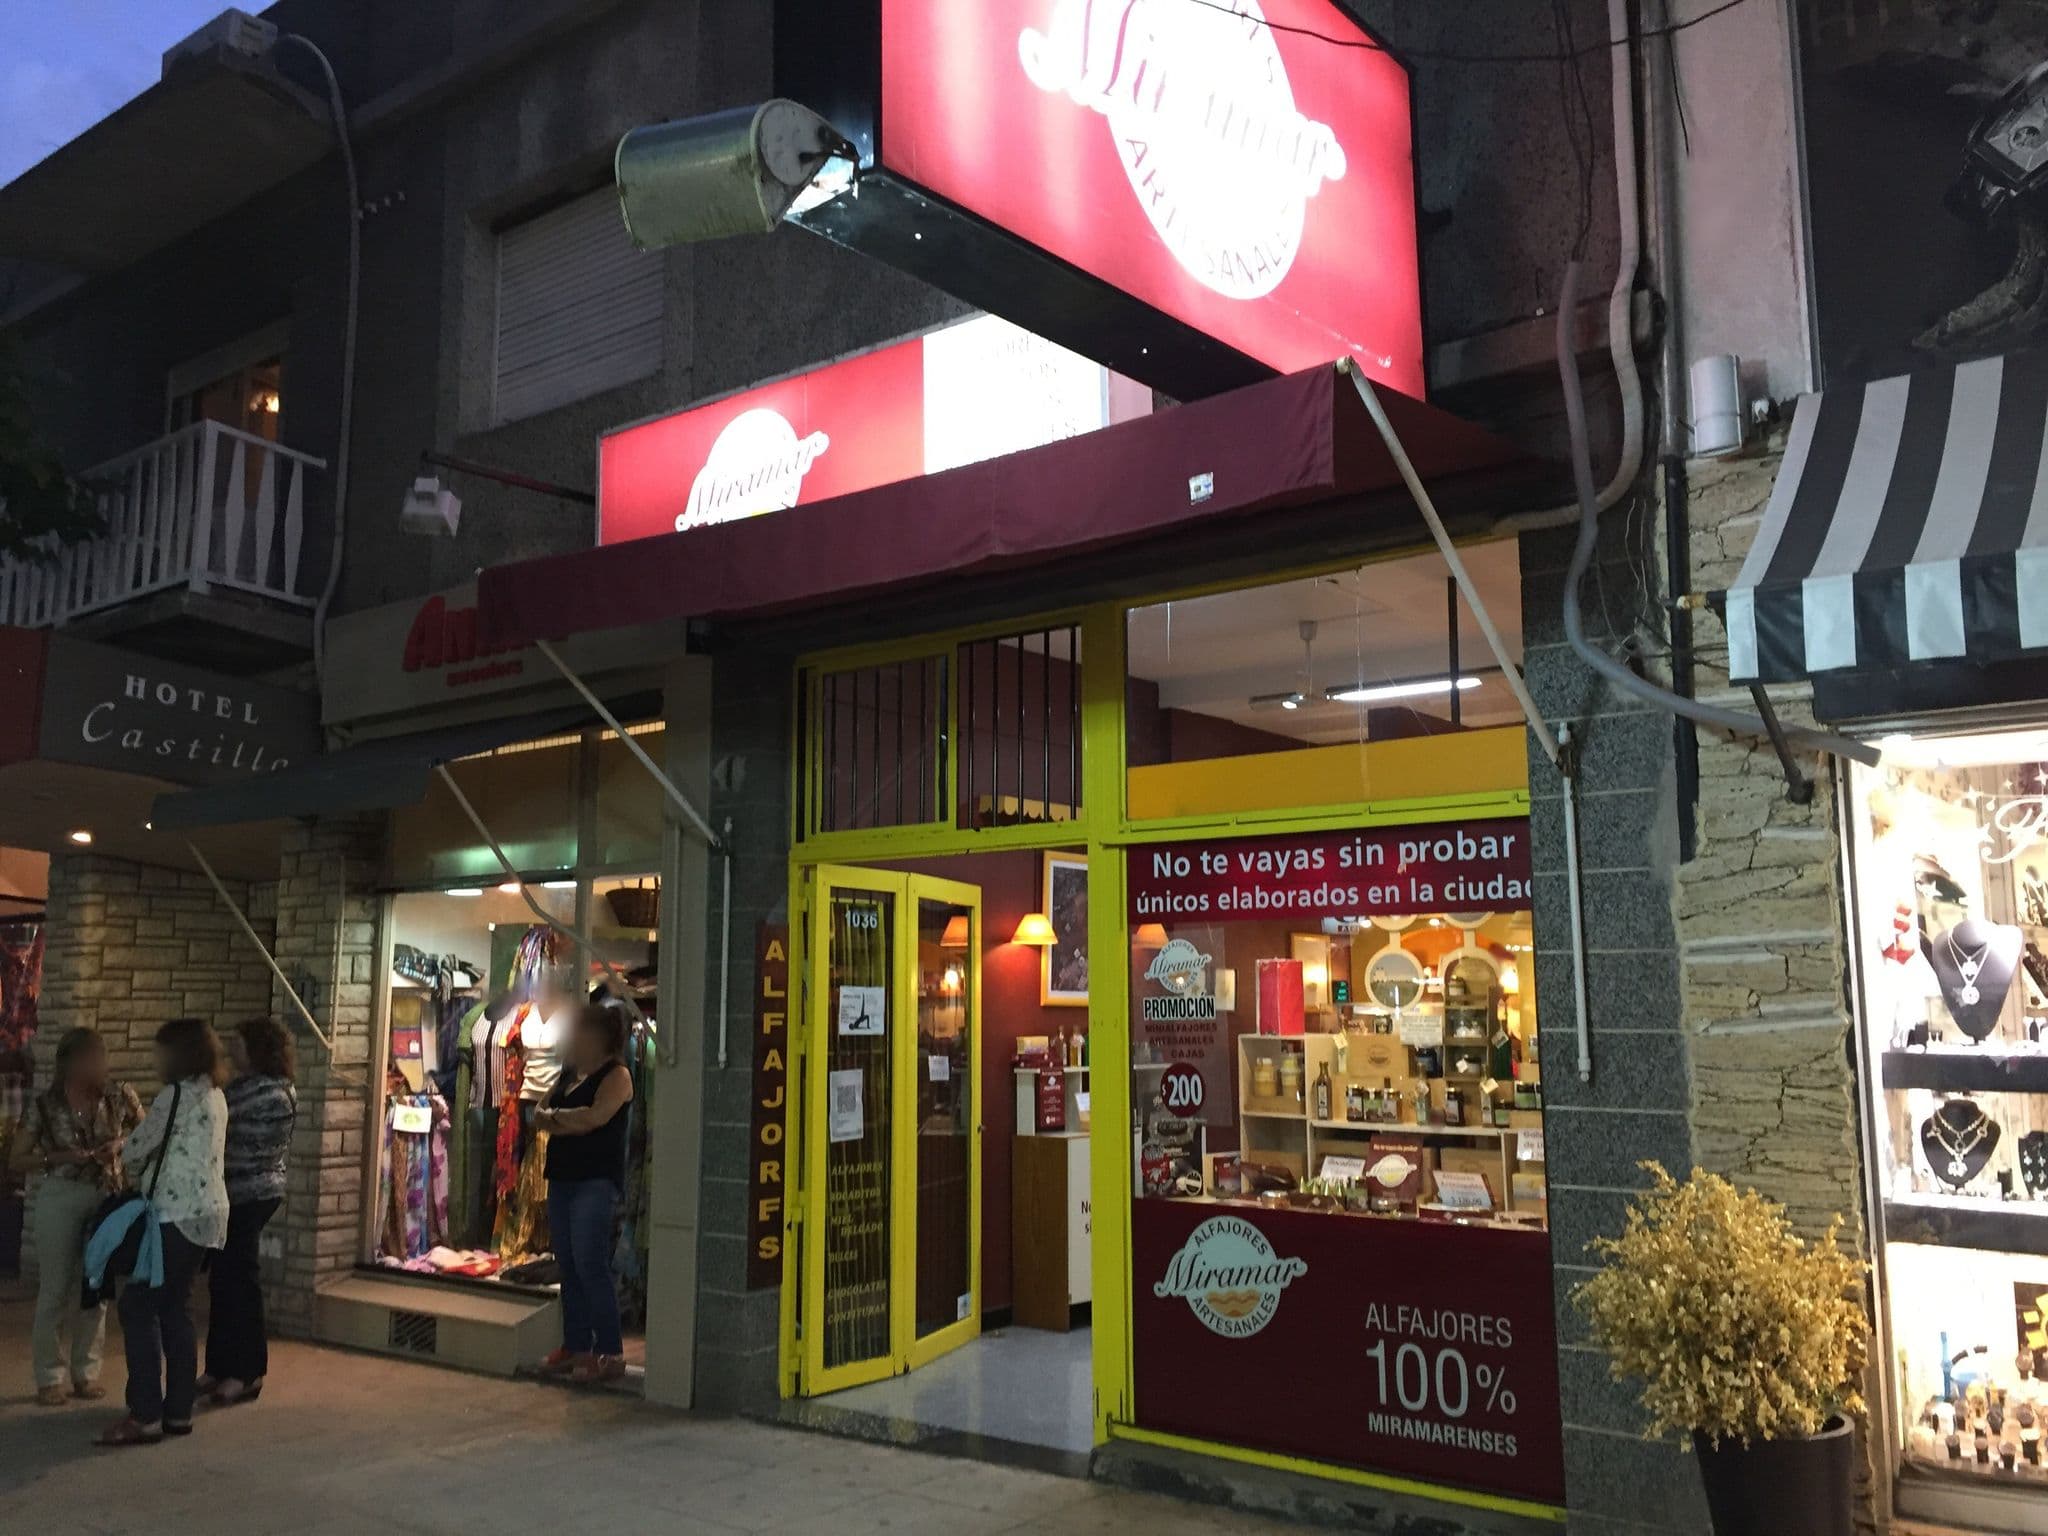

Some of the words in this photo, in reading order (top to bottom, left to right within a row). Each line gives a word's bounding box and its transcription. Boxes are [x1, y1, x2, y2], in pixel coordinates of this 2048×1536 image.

[124, 674, 260, 725] HOTEL
[1152, 851, 1191, 879] No
[1200, 850, 1229, 875] te
[1238, 848, 1326, 879] vayas
[1339, 837, 1384, 868] sin
[1398, 830, 1516, 871] probar
[1136, 890, 1210, 914] únicos
[1217, 882, 1359, 910] elaborados
[1367, 885, 1400, 905] en
[1410, 877, 1434, 902] la
[845, 910, 878, 929] 1036
[1146, 956, 1209, 977] Miramar
[1144, 992, 1215, 1019] PROMOCIÓN
[1171, 1048, 1205, 1058] CAJAS
[1193, 1220, 1269, 1256] ALFAJORES
[1157, 1251, 1298, 1292] Miramar
[1192, 1291, 1276, 1335] ARTESANALES
[1365, 1302, 1513, 1349] ALFAJORES
[1366, 1338, 1517, 1418] 100%
[1368, 1411, 1518, 1457] MIRAMARENSES
